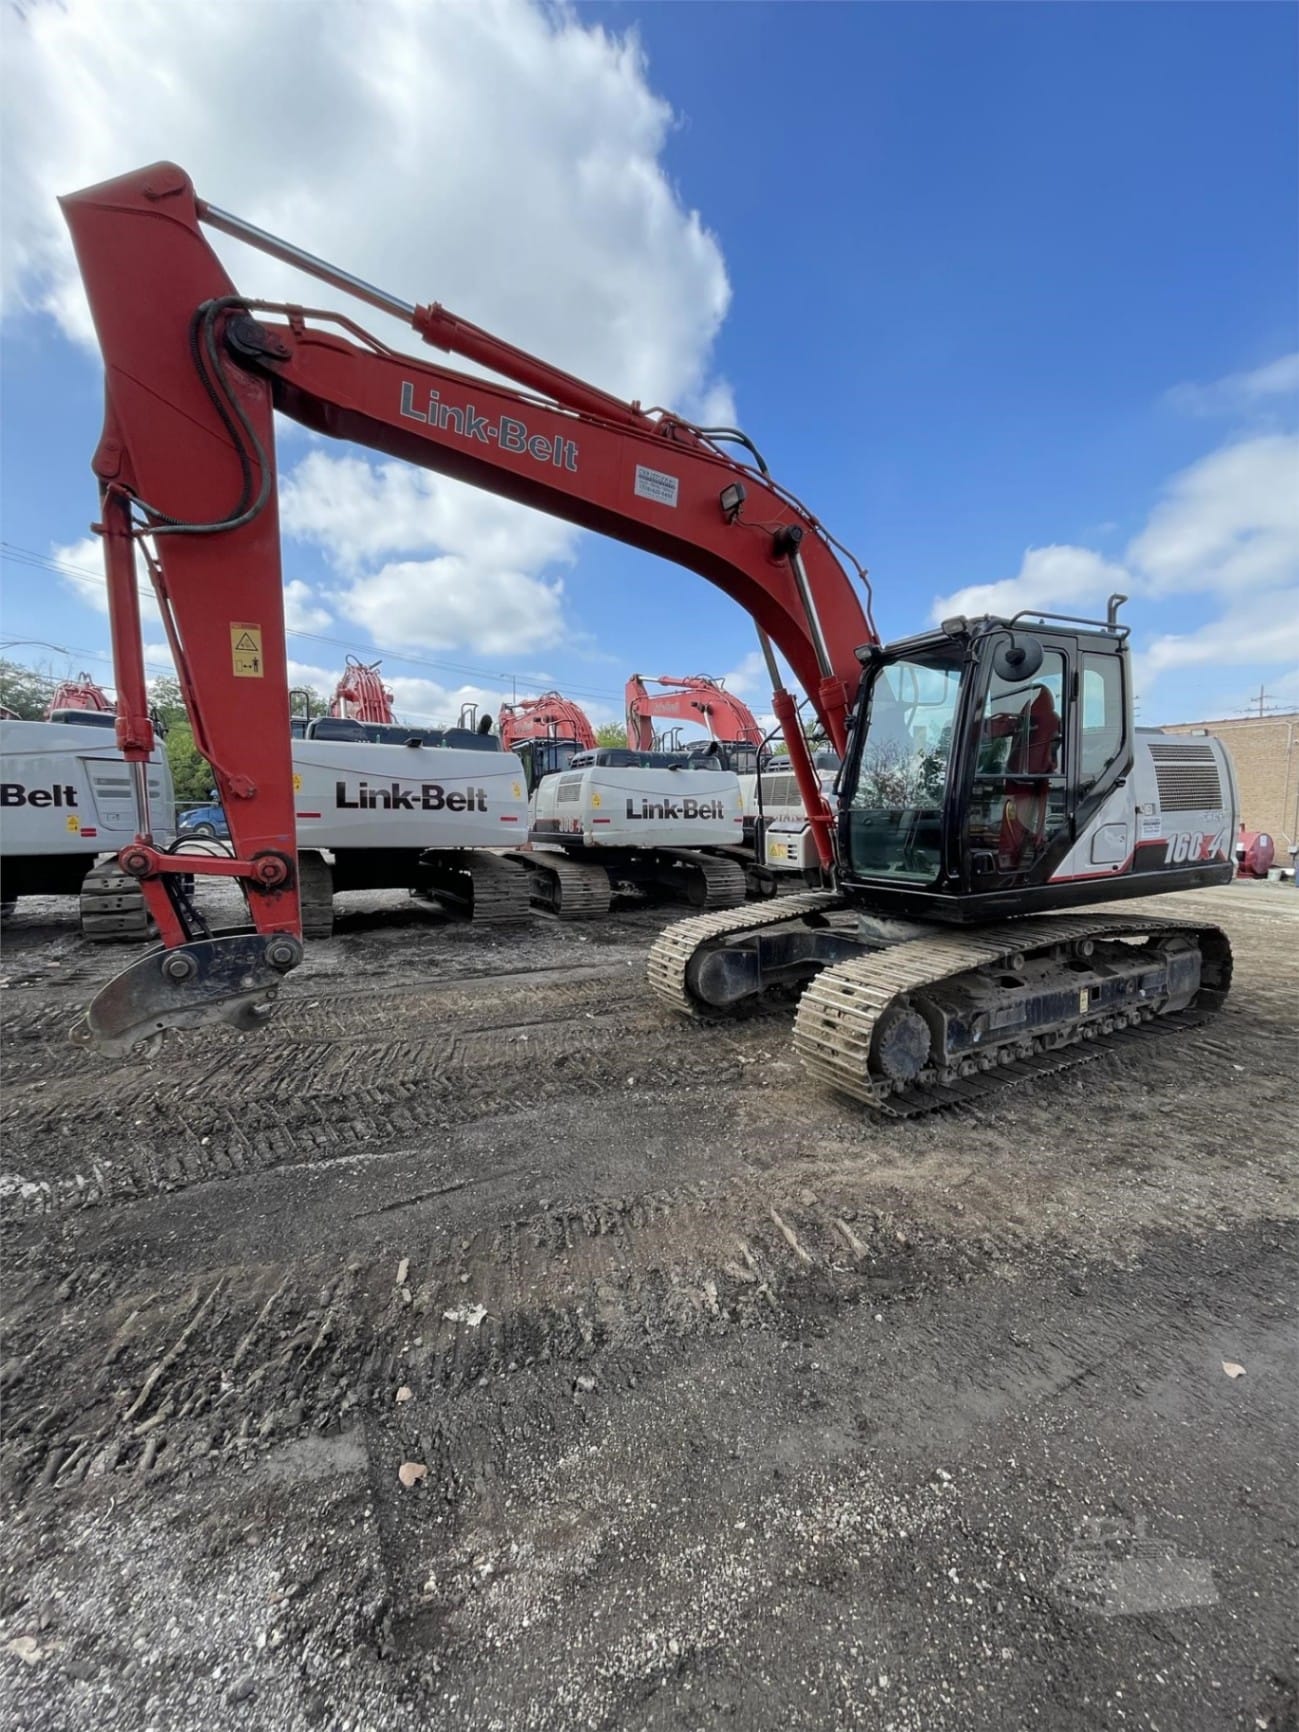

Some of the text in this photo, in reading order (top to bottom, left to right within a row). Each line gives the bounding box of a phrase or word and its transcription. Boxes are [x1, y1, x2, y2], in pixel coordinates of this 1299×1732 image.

[400, 381, 580, 472] Link-Belt
[0, 783, 78, 808] Belt
[336, 781, 488, 812] Link-Belt
[626, 799, 724, 819] Link-Belt
